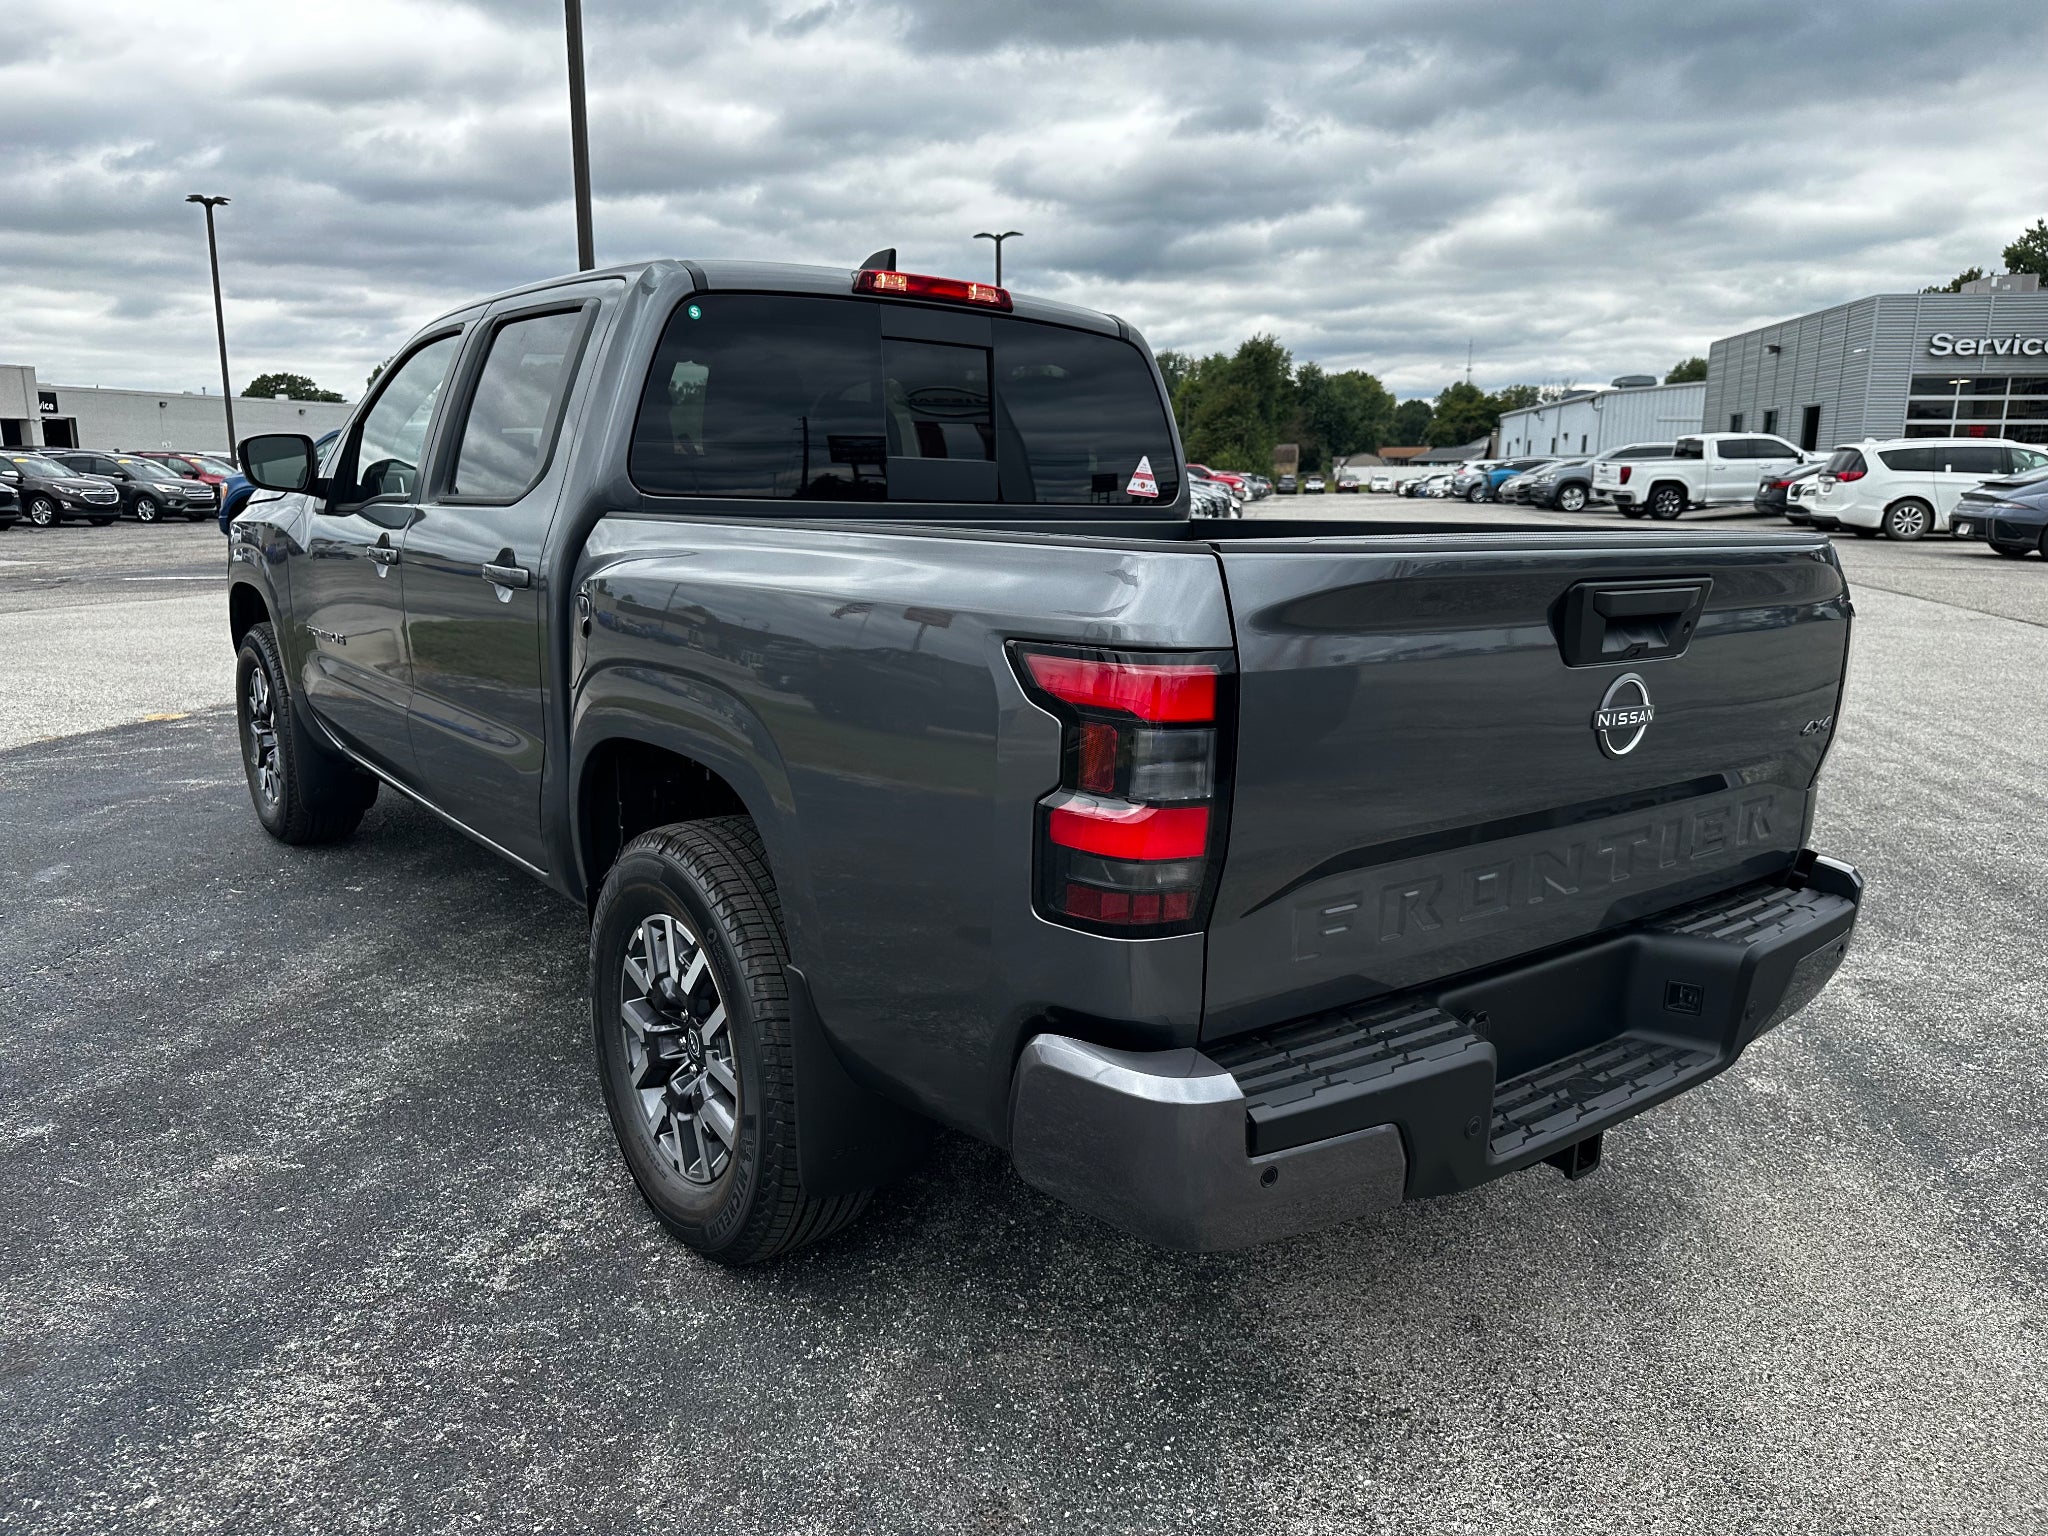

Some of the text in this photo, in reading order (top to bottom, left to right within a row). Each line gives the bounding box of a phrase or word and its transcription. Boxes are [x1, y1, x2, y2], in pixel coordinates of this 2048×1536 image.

[1929, 332, 2048, 356] Servic
[1597, 708, 1655, 727] NISSAN
[1291, 794, 1776, 964] FRONTIER
[705, 1165, 749, 1241] MICHELIN
